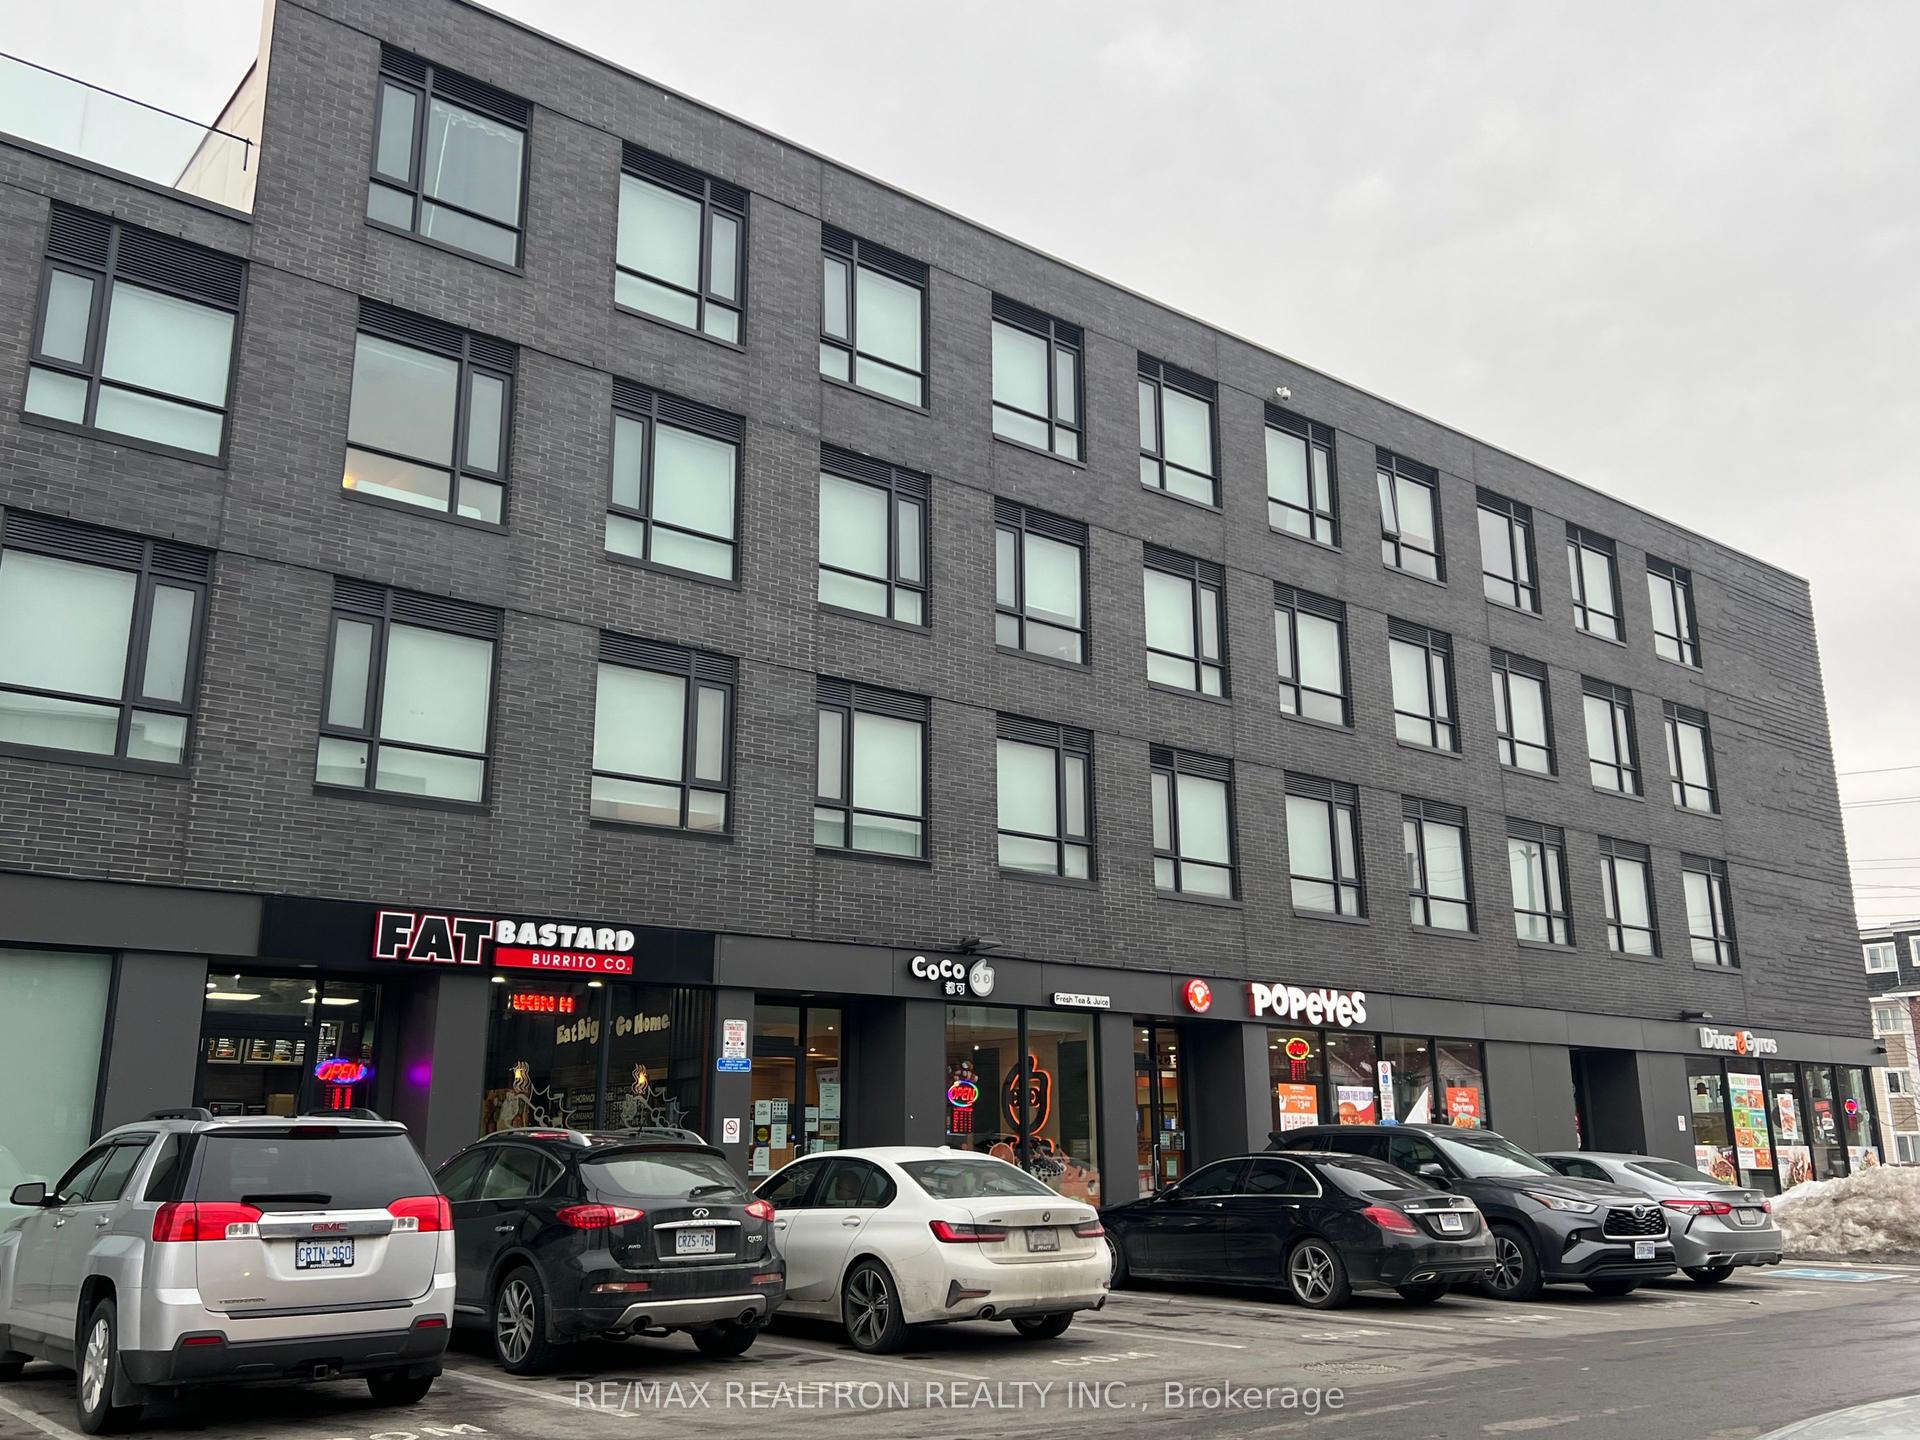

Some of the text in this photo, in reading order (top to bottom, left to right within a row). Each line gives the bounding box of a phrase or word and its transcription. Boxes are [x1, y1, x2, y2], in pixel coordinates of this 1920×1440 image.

[373, 911, 635, 965] FAT BASTARD
[532, 953, 630, 971] BURRITO CO.
[945, 981, 966, 996] 都可
[1056, 995, 1109, 1006] Fresh Tea & Juice
[557, 1024, 577, 1045] Eat
[578, 1016, 599, 1044] Big
[616, 1015, 632, 1036] Go
[1743, 1030, 1778, 1057] Gyros
[319, 1064, 363, 1081] OPEN
[950, 1086, 976, 1101] OPEN
[311, 1222, 348, 1233] GMC
[700, 1234, 714, 1247] 764
[332, 1245, 351, 1260] 960
